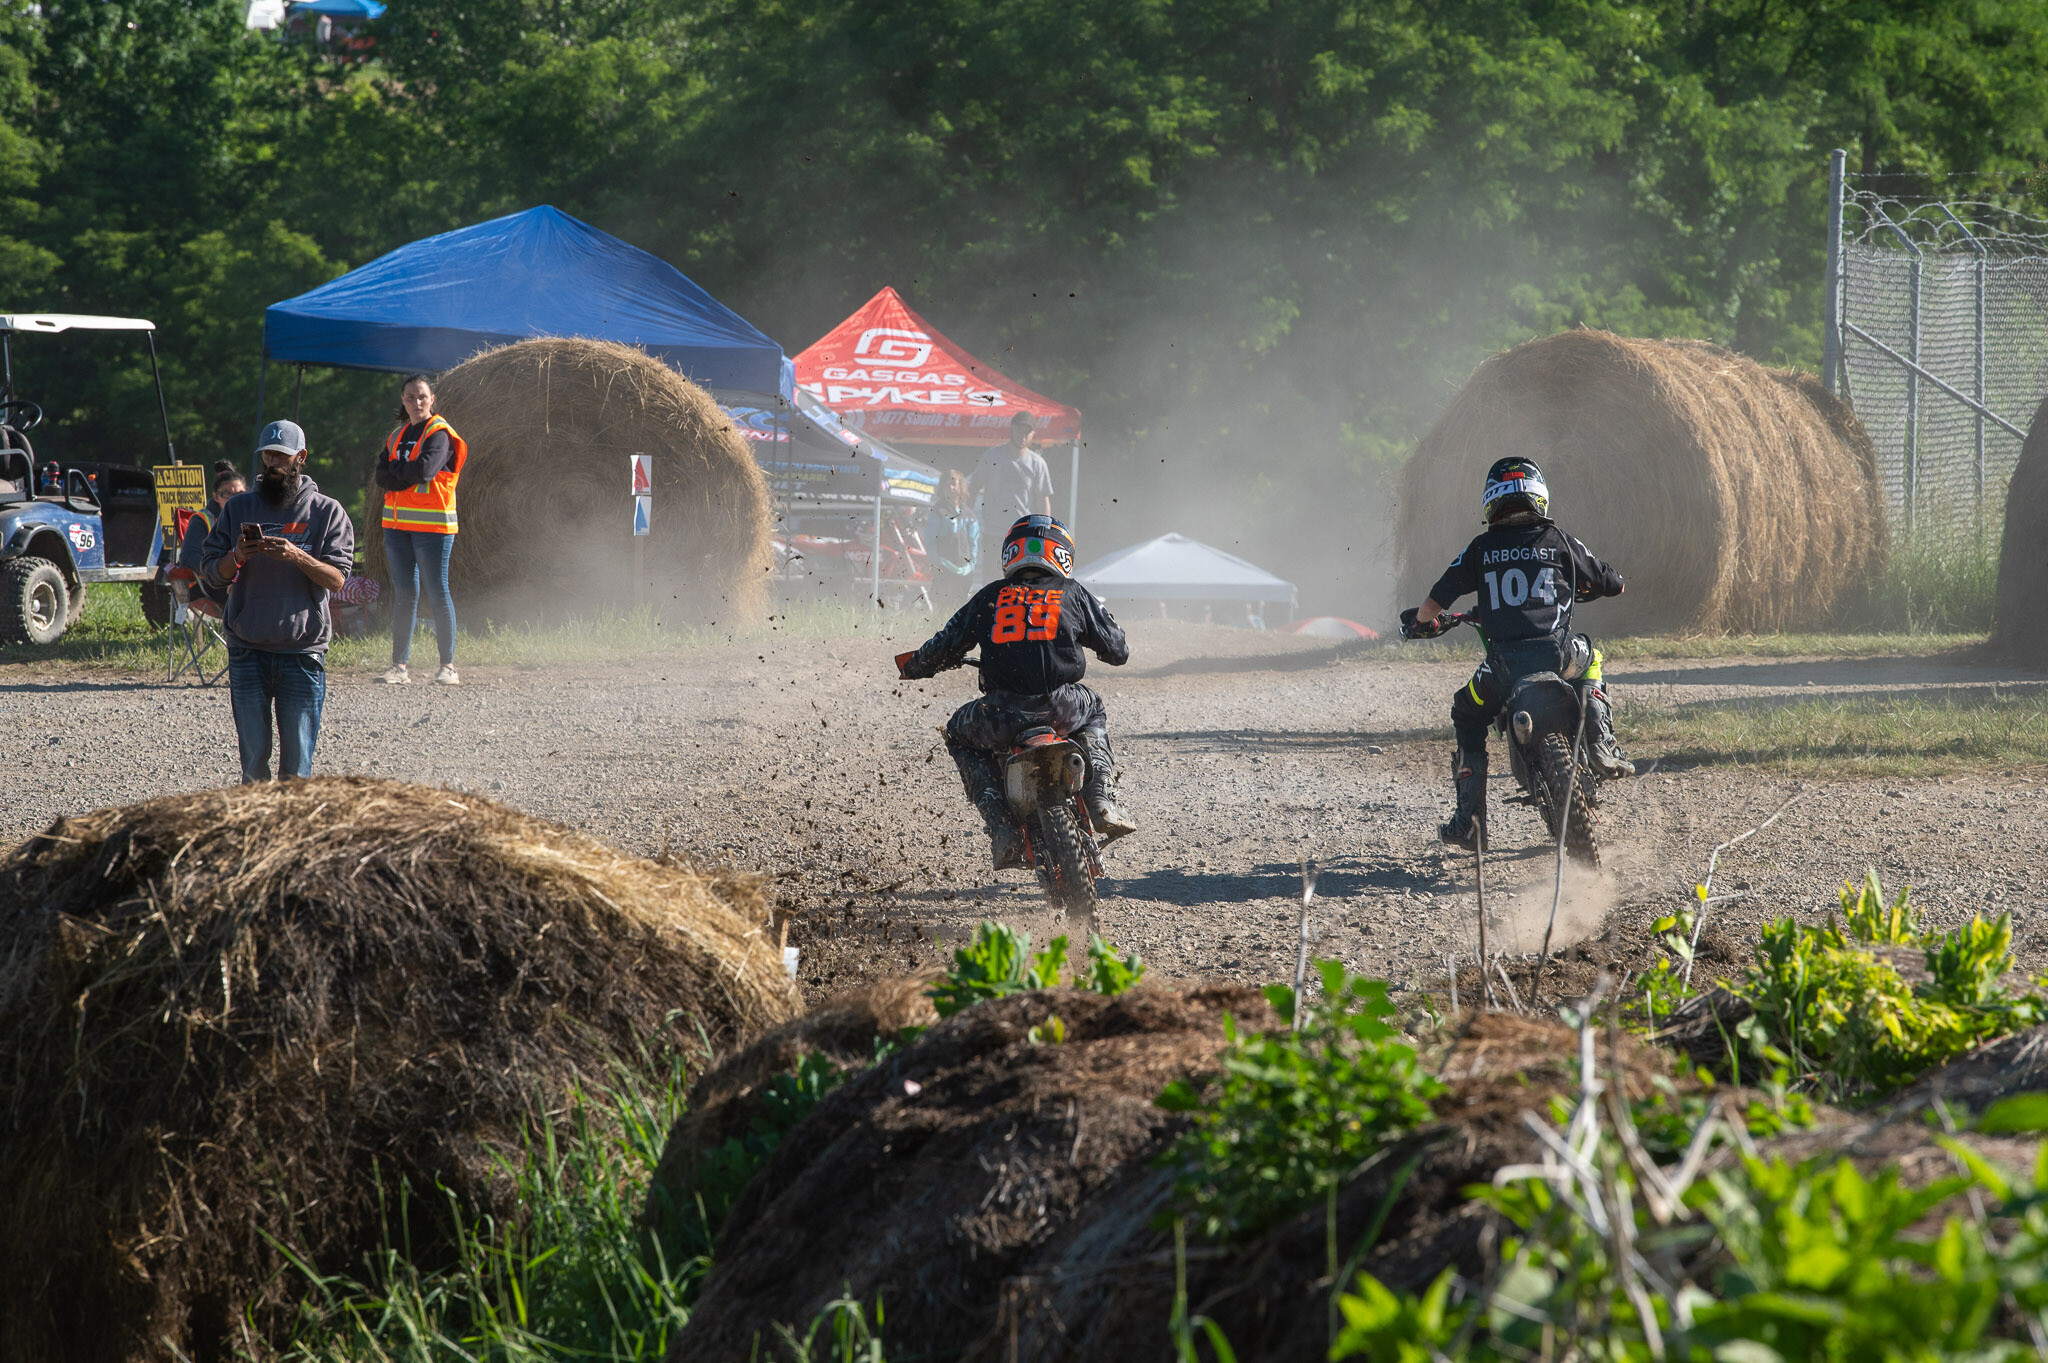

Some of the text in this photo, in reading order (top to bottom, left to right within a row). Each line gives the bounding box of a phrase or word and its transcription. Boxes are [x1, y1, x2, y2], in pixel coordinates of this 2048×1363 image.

[823, 367, 966, 386] GASGAS
[871, 411, 904, 425] 3477
[904, 412, 944, 427] South
[163, 469, 202, 486] CAUTION
[160, 490, 203, 504] TRACK CROSSING
[80, 533, 93, 548] 96
[1483, 547, 1557, 566] ARBOGAST
[1484, 567, 1558, 611] 104
[995, 589, 1064, 609] RICE
[991, 603, 1061, 644] 89
